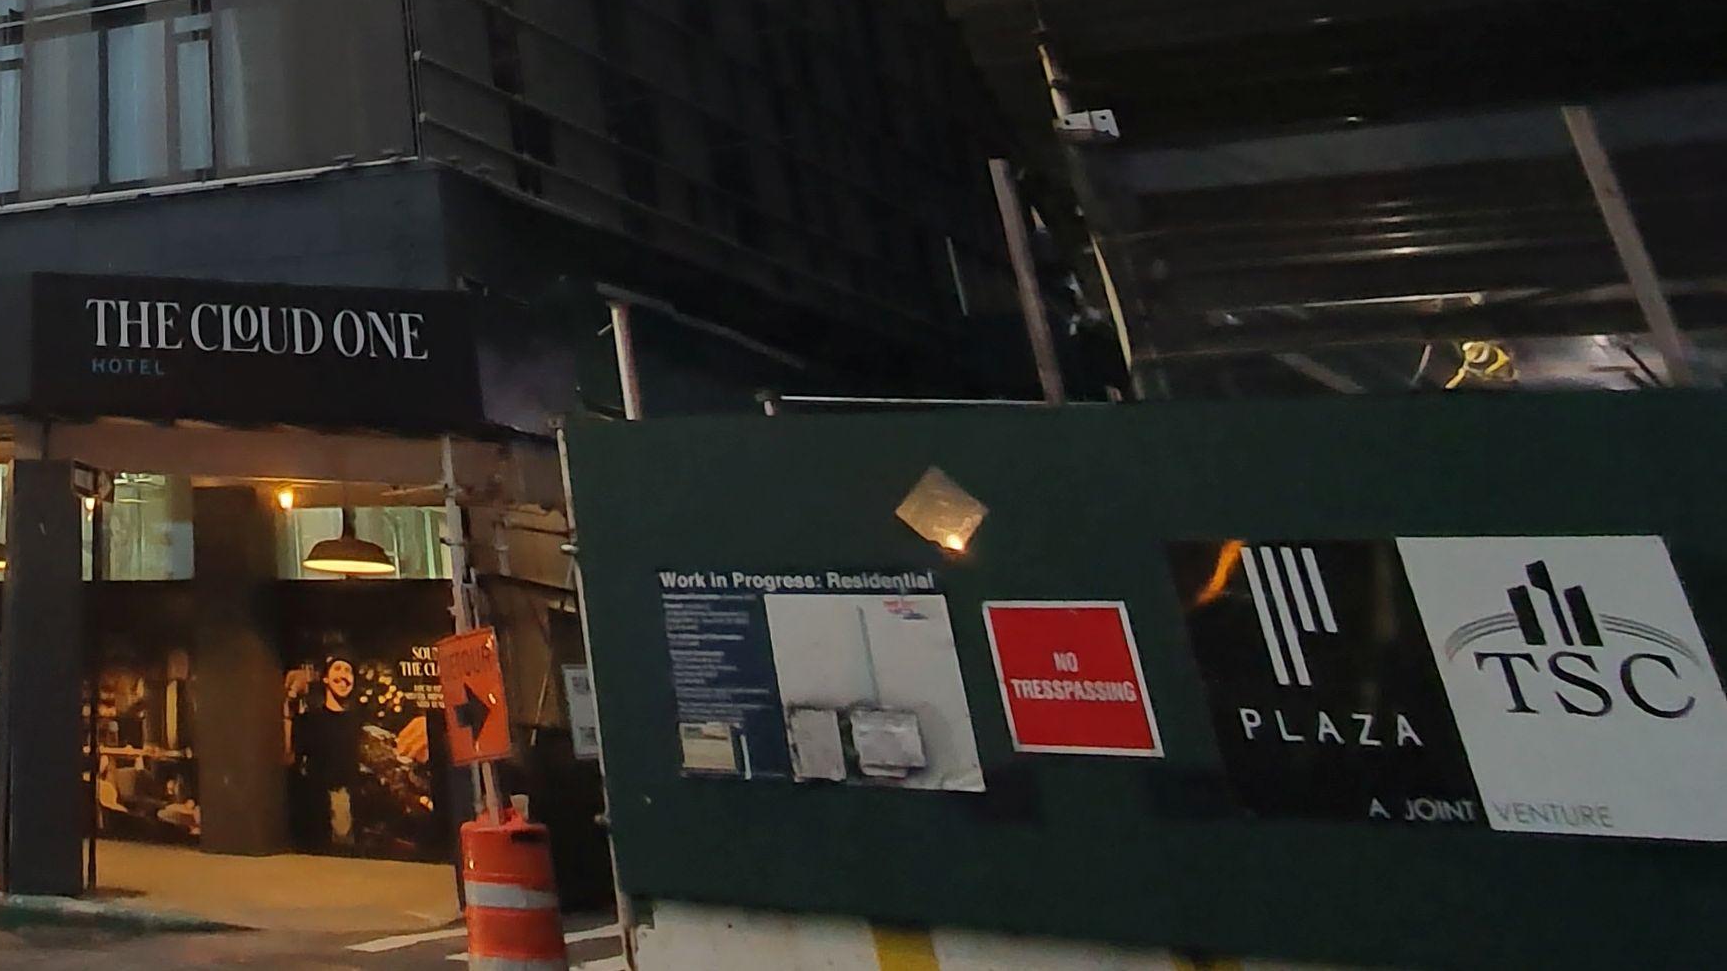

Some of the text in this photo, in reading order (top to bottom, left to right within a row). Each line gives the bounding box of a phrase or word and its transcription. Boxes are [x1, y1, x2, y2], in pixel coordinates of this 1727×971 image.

[86, 298, 428, 360] THE CLOUD ONE
[92, 358, 166, 376] HOTEL
[659, 571, 934, 592] Work in Progress: Residential
[399, 661, 423, 677] THE
[1053, 651, 1079, 672] NO
[1010, 679, 1137, 702] TRESSPASSING
[1476, 652, 1697, 718] TSC
[1239, 708, 1423, 747] PLAZA
[1370, 798, 1616, 829] A JOINT VENTURE
